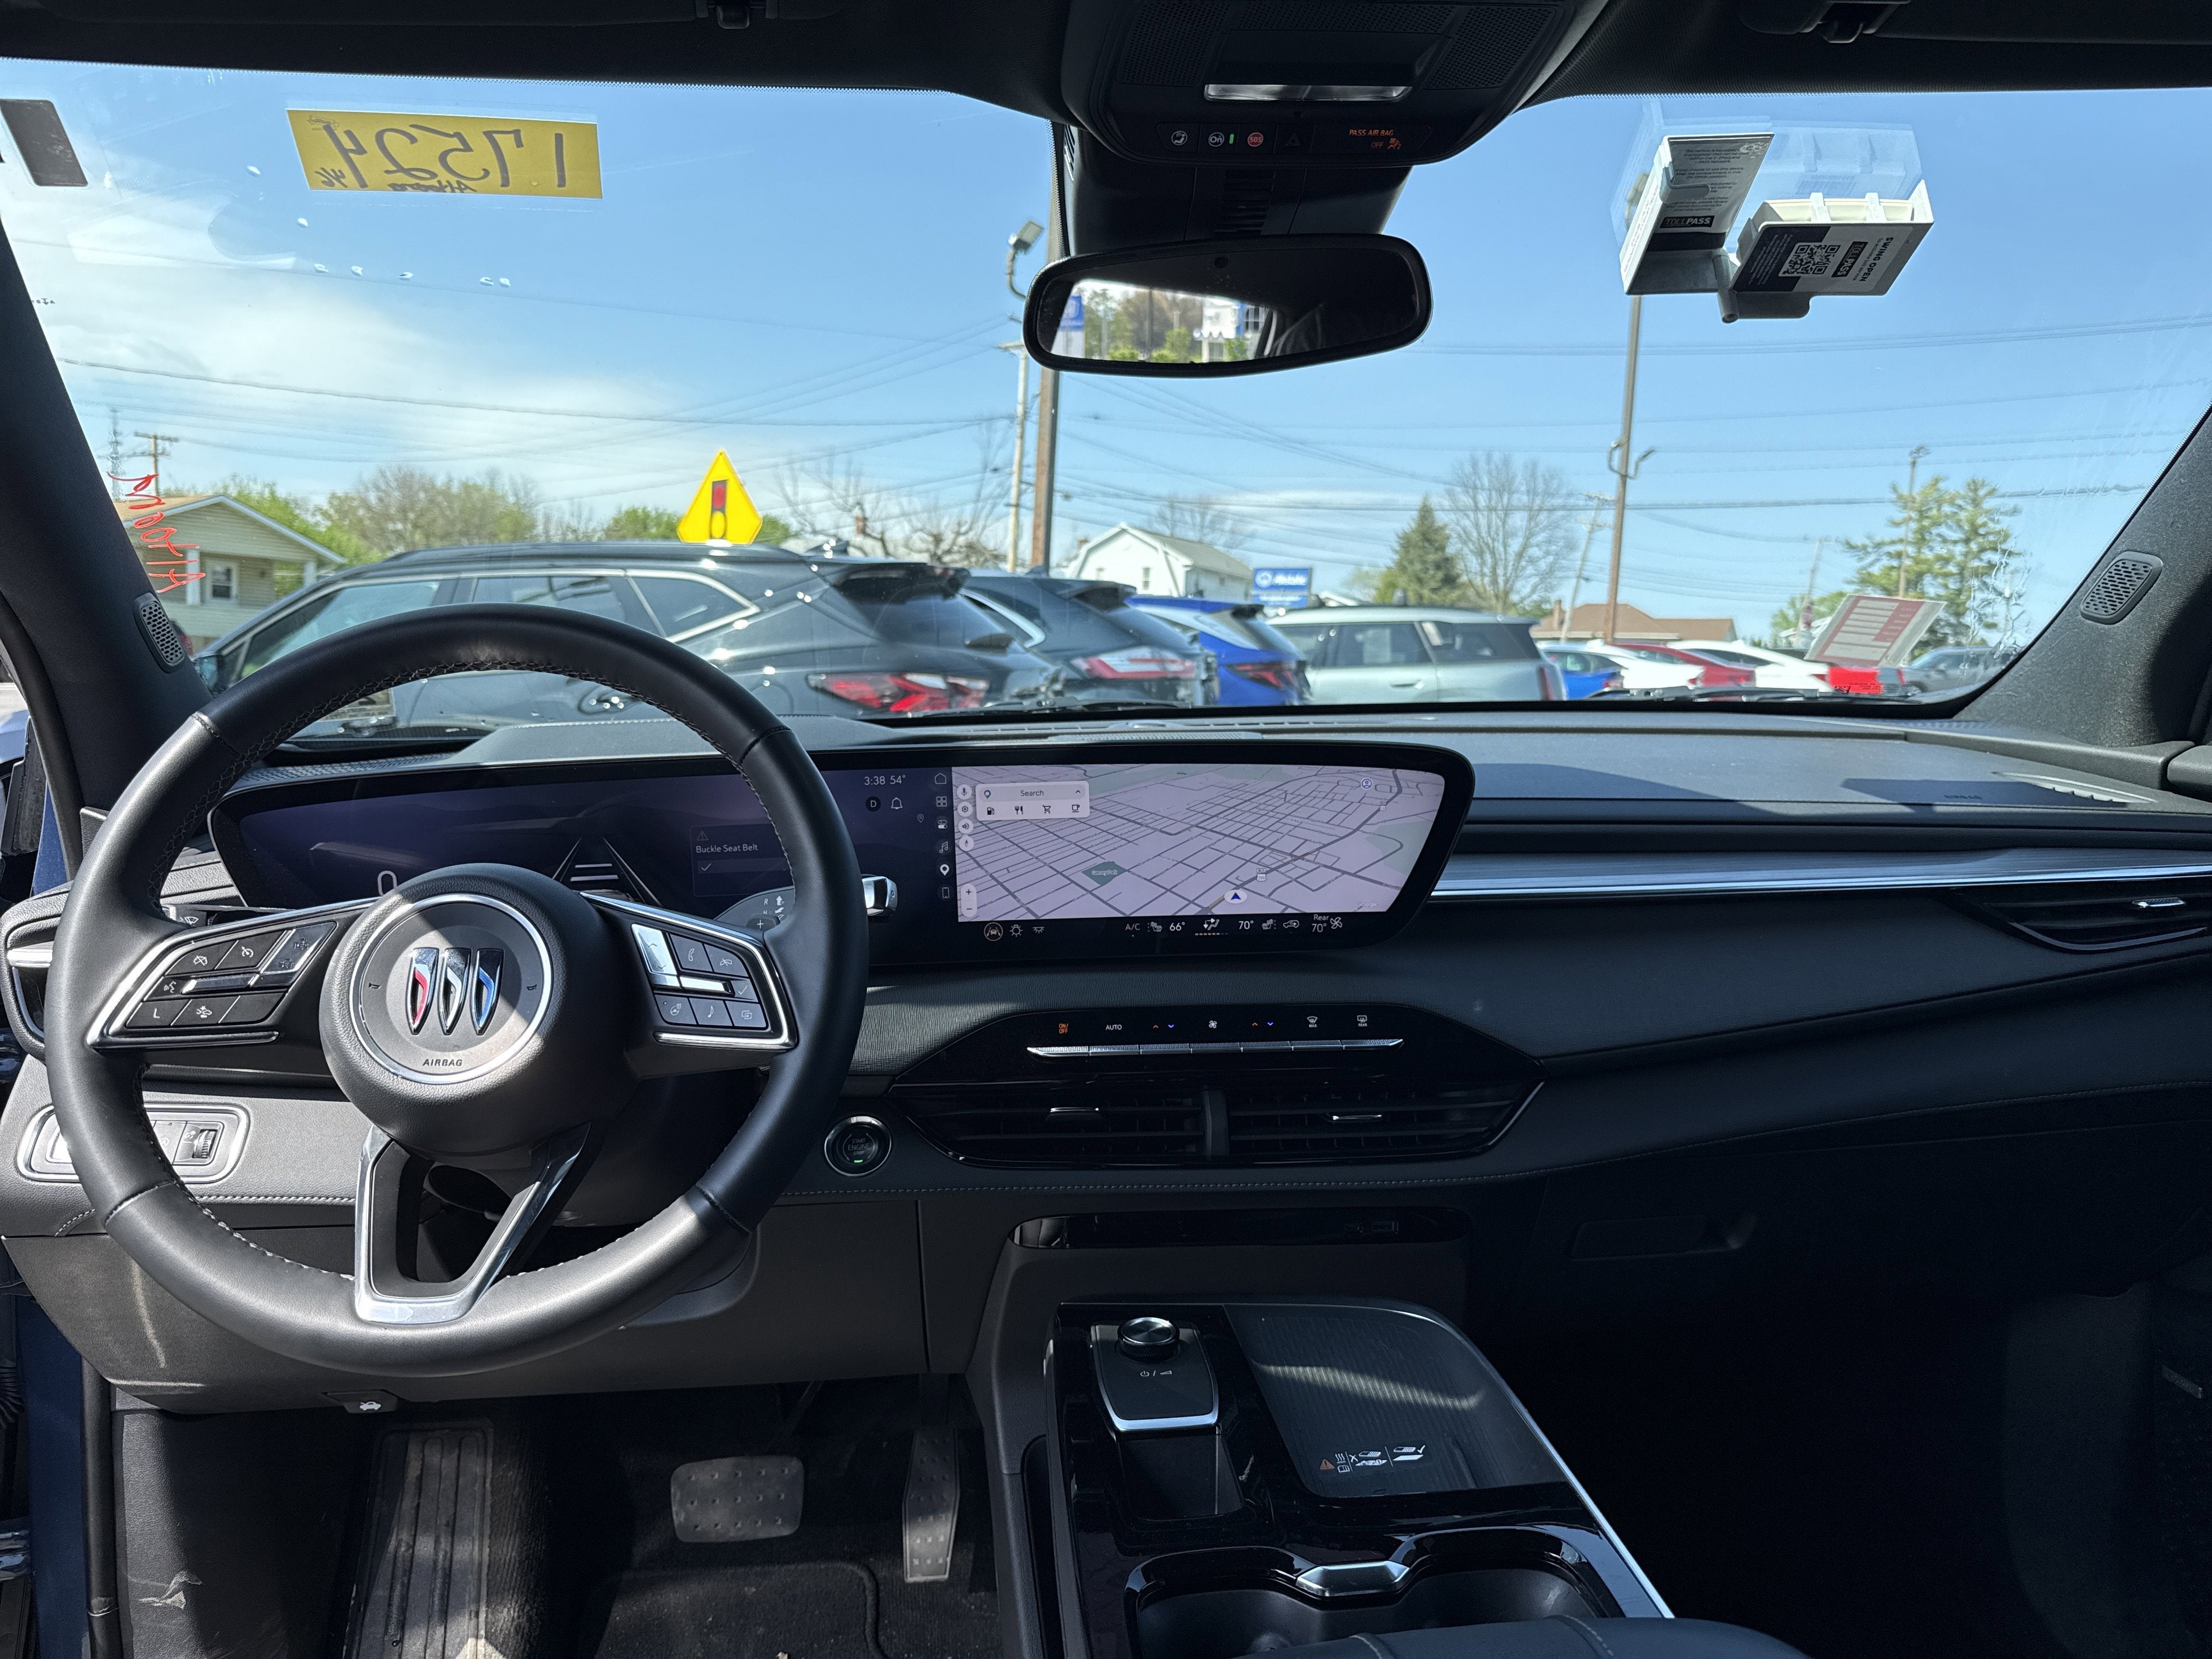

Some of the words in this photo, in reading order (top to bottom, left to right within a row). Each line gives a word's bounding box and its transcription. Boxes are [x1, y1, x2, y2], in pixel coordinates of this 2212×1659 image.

[1873, 237, 1894, 262] SWING
[1859, 262, 1877, 281] OPEN
[864, 776, 885, 786] 3:38
[890, 775, 906, 785] 54°
[696, 845, 722, 853] Buckle
[723, 844, 741, 853] Seat
[1355, 900, 1378, 909] Google
[1125, 923, 1141, 932] A/C
[1169, 922, 1186, 932] 66°
[1238, 920, 1254, 930] 70°
[1311, 923, 1327, 933] 70°
[154, 1008, 160, 1019] L
[848, 1143, 870, 1152] ENGINE
